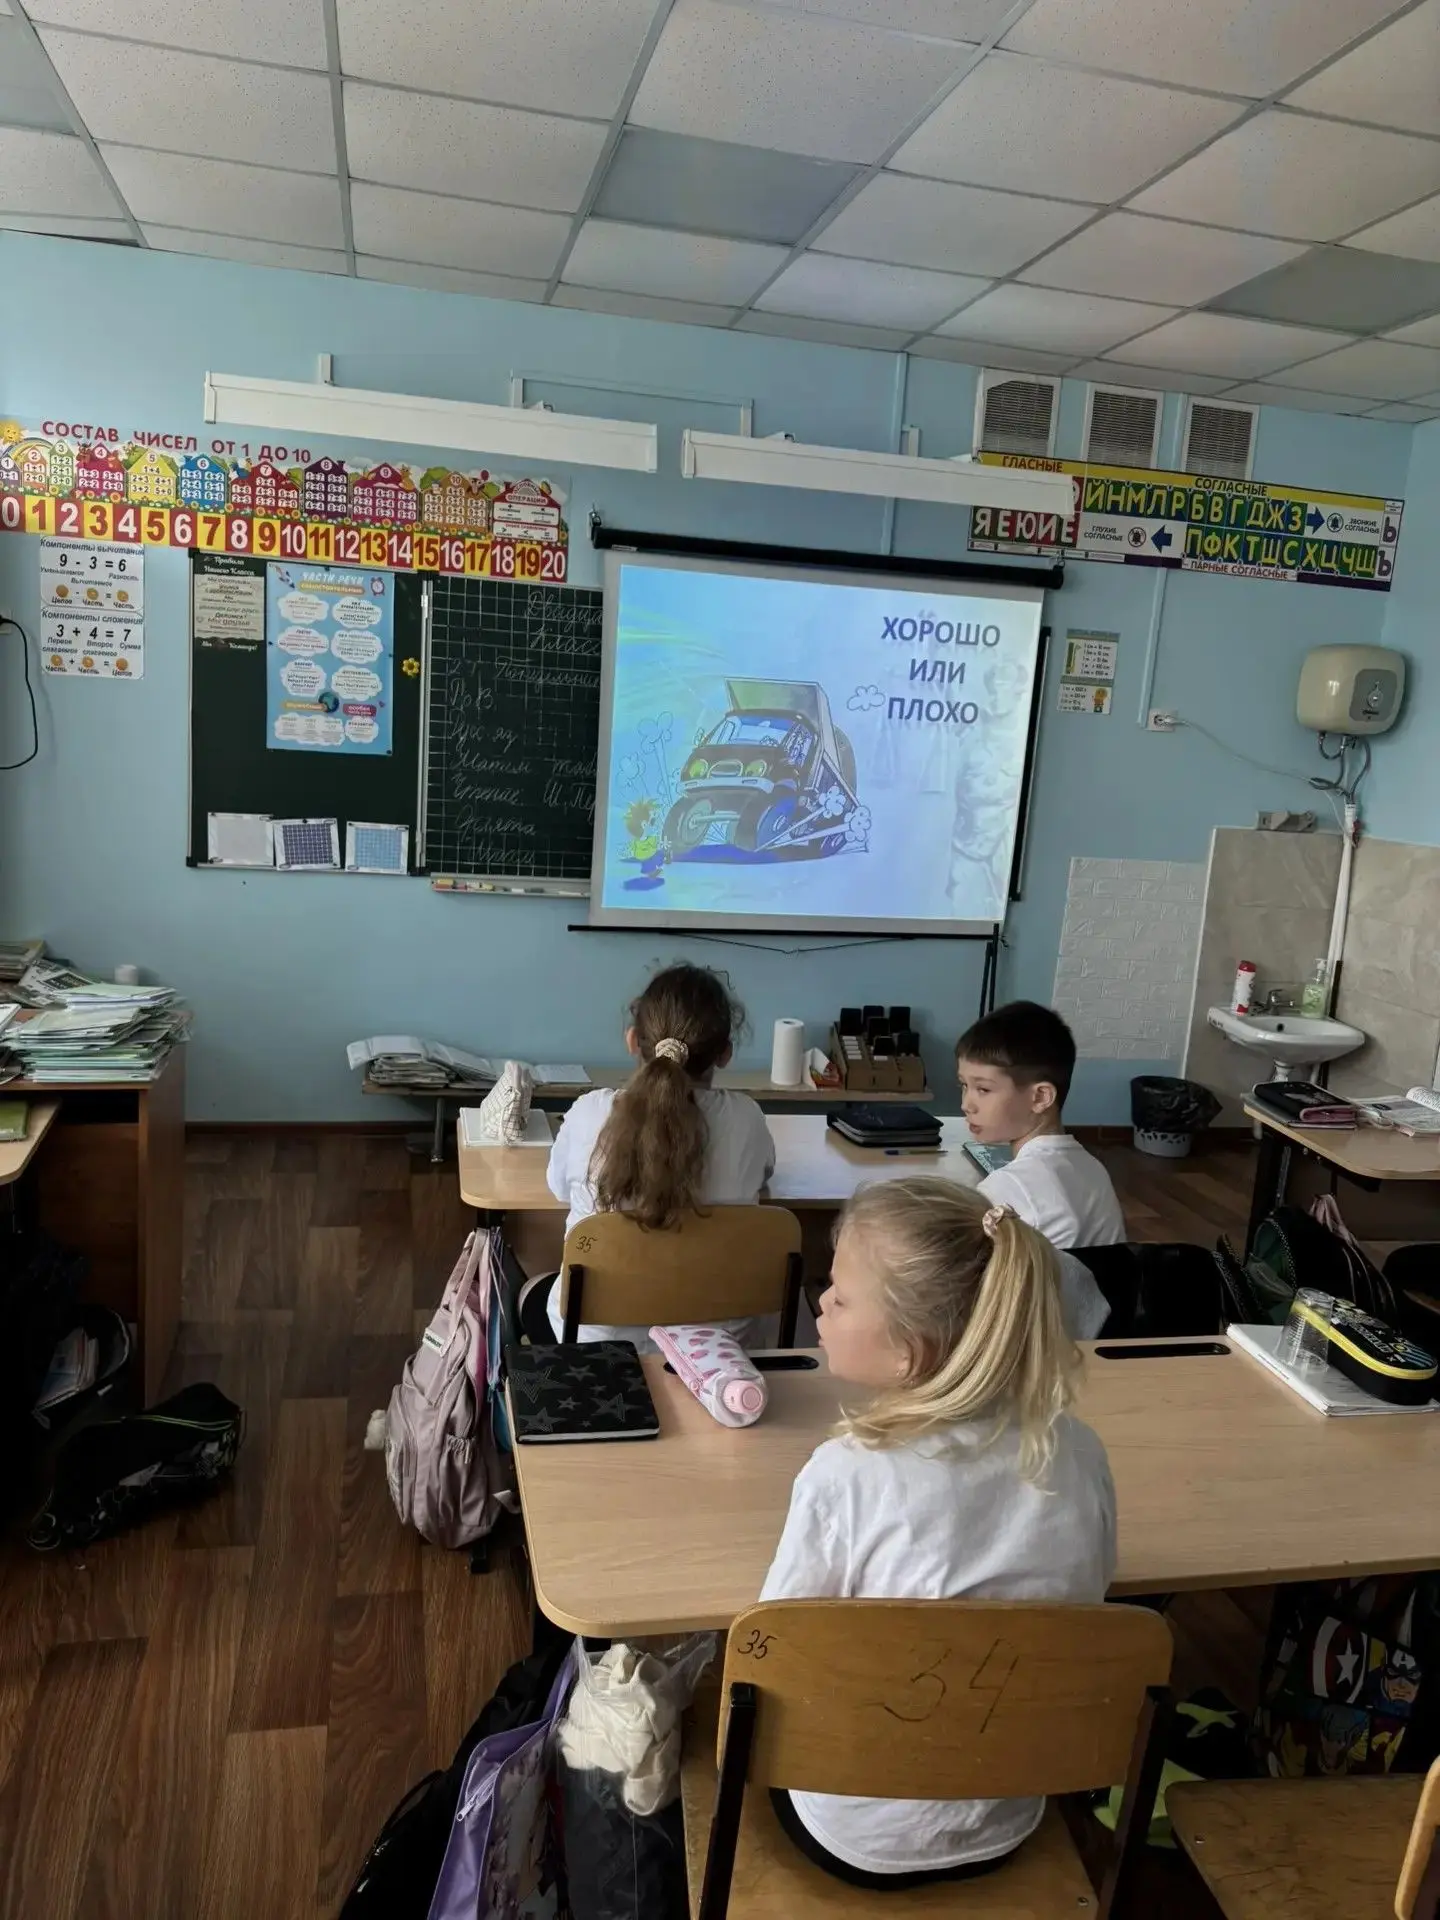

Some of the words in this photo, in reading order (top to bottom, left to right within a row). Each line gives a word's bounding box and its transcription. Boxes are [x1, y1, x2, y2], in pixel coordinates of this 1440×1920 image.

[42, 421, 119, 441] СОСТАВ
[133, 430, 197, 451] ЧИСЕЛ
[212, 440, 235, 455] ОТ
[241, 444, 250, 457] 1
[258, 445, 288, 462] ДО
[292, 449, 311, 463] 10
[1002, 456, 1063, 472] ГЛАСНЫЕ
[1195, 478, 1268, 496] СОГЛАСНЫЕ
[2, 496, 20, 528] 0
[32, 500, 46, 530] 1
[60, 502, 79, 533] 2
[89, 505, 108, 536] 3
[118, 508, 137, 538] 4
[147, 511, 165, 541] 5
[174, 513, 192, 544] 6
[202, 516, 221, 546] 7
[230, 519, 248, 549] 8
[258, 521, 276, 552] 9
[281, 523, 306, 554] 10
[309, 527, 331, 557] 11
[335, 529, 360, 560] 12
[361, 531, 387, 562] 13
[388, 535, 412, 564] 14
[414, 537, 439, 567] 15
[440, 540, 465, 569] 16
[465, 543, 490, 572] 17
[491, 545, 514, 574] 18
[516, 548, 540, 577] 19
[541, 551, 566, 579] 20
[40, 539, 95, 551] Компоненты
[1084, 532, 1123, 542] СОГЛАСНЫЕ
[59, 554, 68, 567] 9
[89, 556, 97, 569] 3
[118, 559, 127, 572] 6
[1191, 560, 1229, 574] ПАРНЫЕ
[1231, 565, 1288, 579] СОГЛАСНЫЕ
[42, 610, 100, 622] Компоненты
[56, 624, 64, 637] 3
[89, 626, 97, 639] 4
[123, 629, 131, 641] 7
[881, 616, 1000, 647] ХОРОШО
[909, 658, 965, 684] ИЛИ
[888, 697, 978, 723] ПЛОХО
[576, 1236, 598, 1253] 35
[738, 1629, 776, 1660] 35
[872, 1638, 1019, 1733] 34
